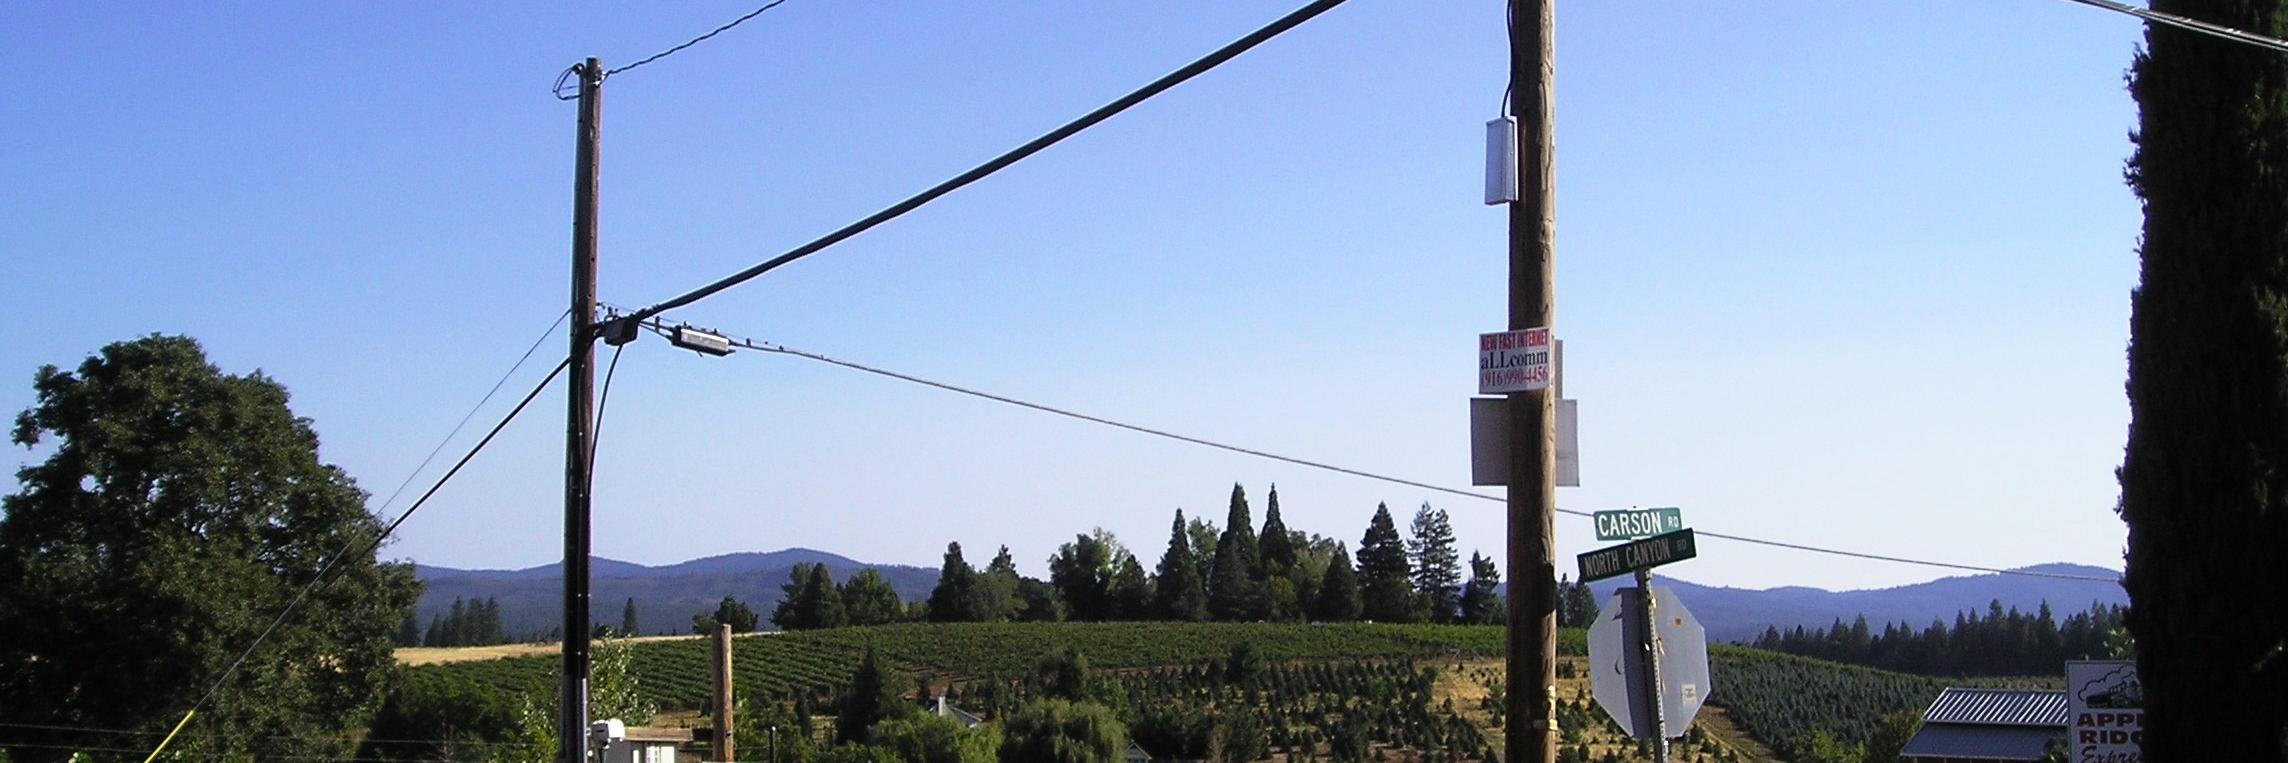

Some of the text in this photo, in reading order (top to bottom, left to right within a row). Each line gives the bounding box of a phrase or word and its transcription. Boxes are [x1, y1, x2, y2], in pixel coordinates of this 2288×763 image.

[1481, 329, 1549, 351] NEW FAST INTERNET
[1598, 511, 1679, 537] CARSON RD
[1584, 538, 1687, 577] NORTH CANYON RD
[2077, 713, 2144, 729] APP
